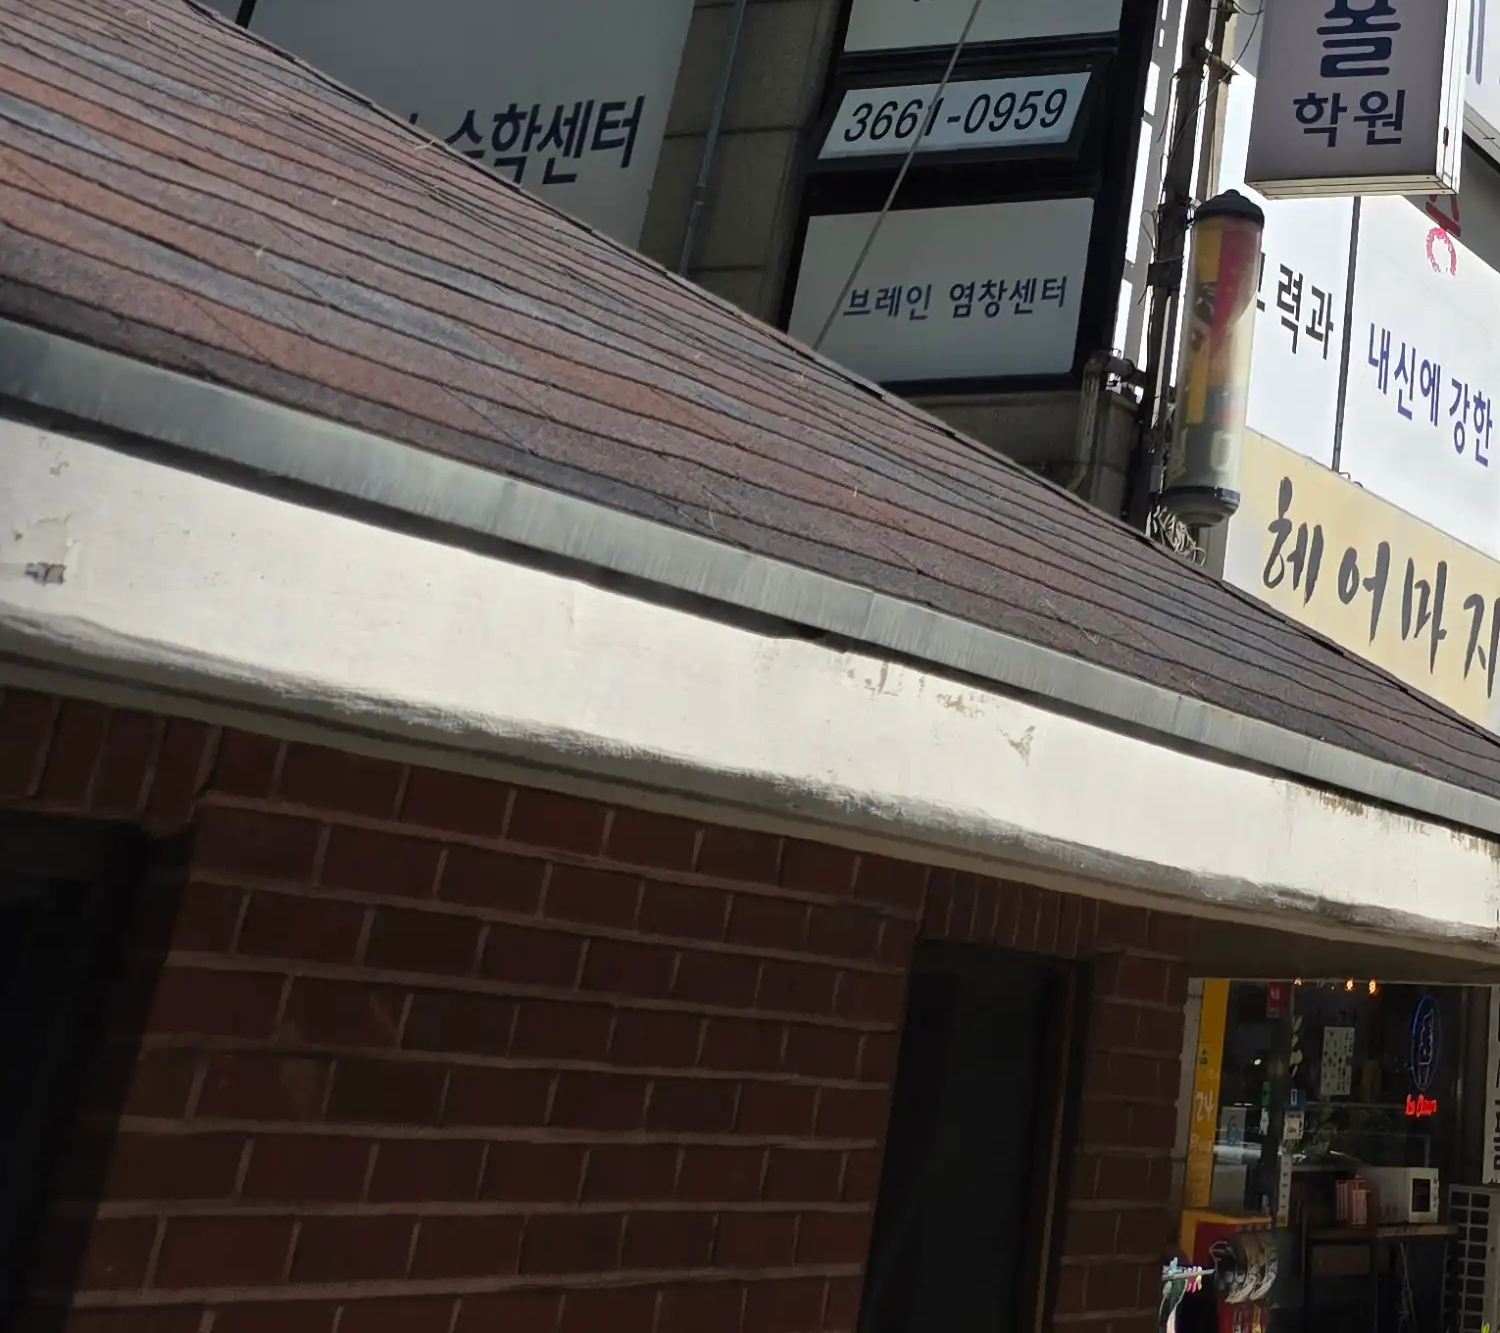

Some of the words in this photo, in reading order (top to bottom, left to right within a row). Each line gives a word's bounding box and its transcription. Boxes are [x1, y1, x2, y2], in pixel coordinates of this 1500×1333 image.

[843, 87, 1068, 144] 3661-0959
[1293, 89, 1406, 148] 학원
[843, 283, 934, 322] 브레인
[949, 275, 1068, 320] 염창센터
[1367, 322, 1441, 427] 내신에
[1448, 377, 1493, 468] 강한
